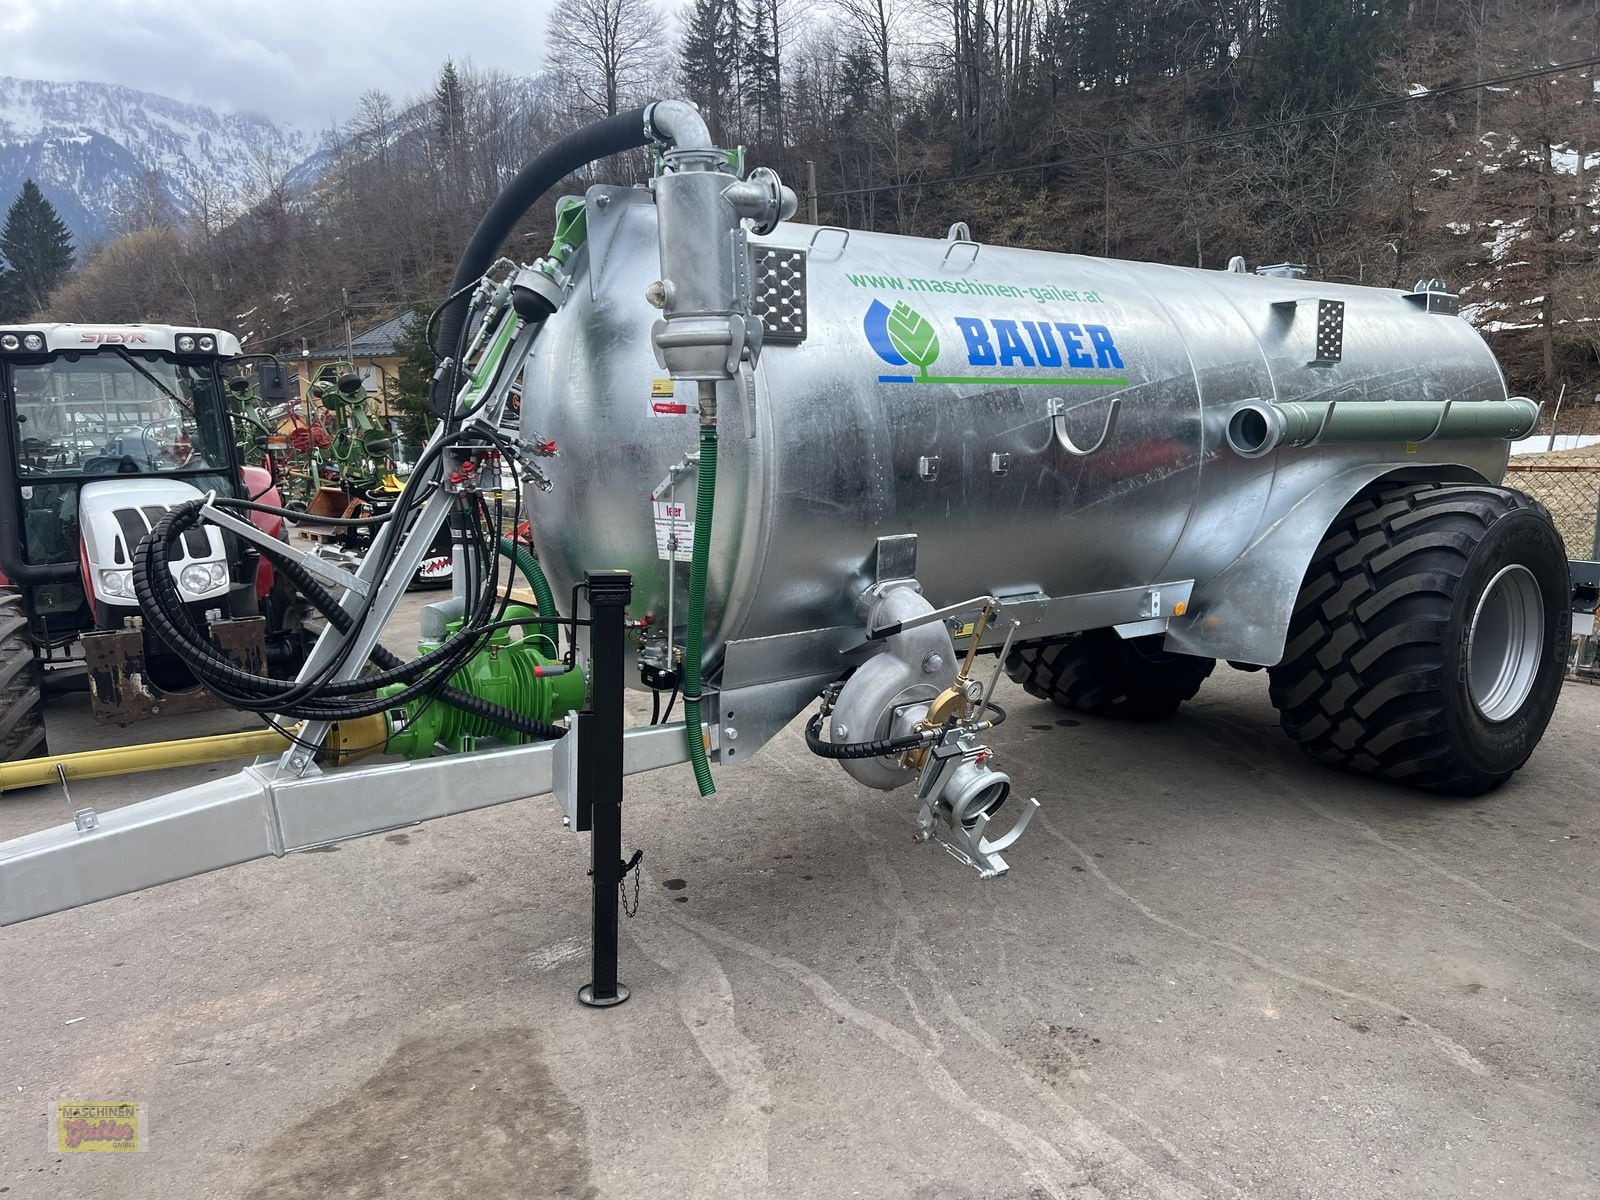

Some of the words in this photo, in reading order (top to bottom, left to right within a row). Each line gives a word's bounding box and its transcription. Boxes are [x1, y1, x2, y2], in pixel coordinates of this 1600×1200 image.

[845, 273, 1104, 305] www.maschinen-gailer.at
[80, 333, 147, 343] STEYR
[954, 317, 1125, 369] BAUER
